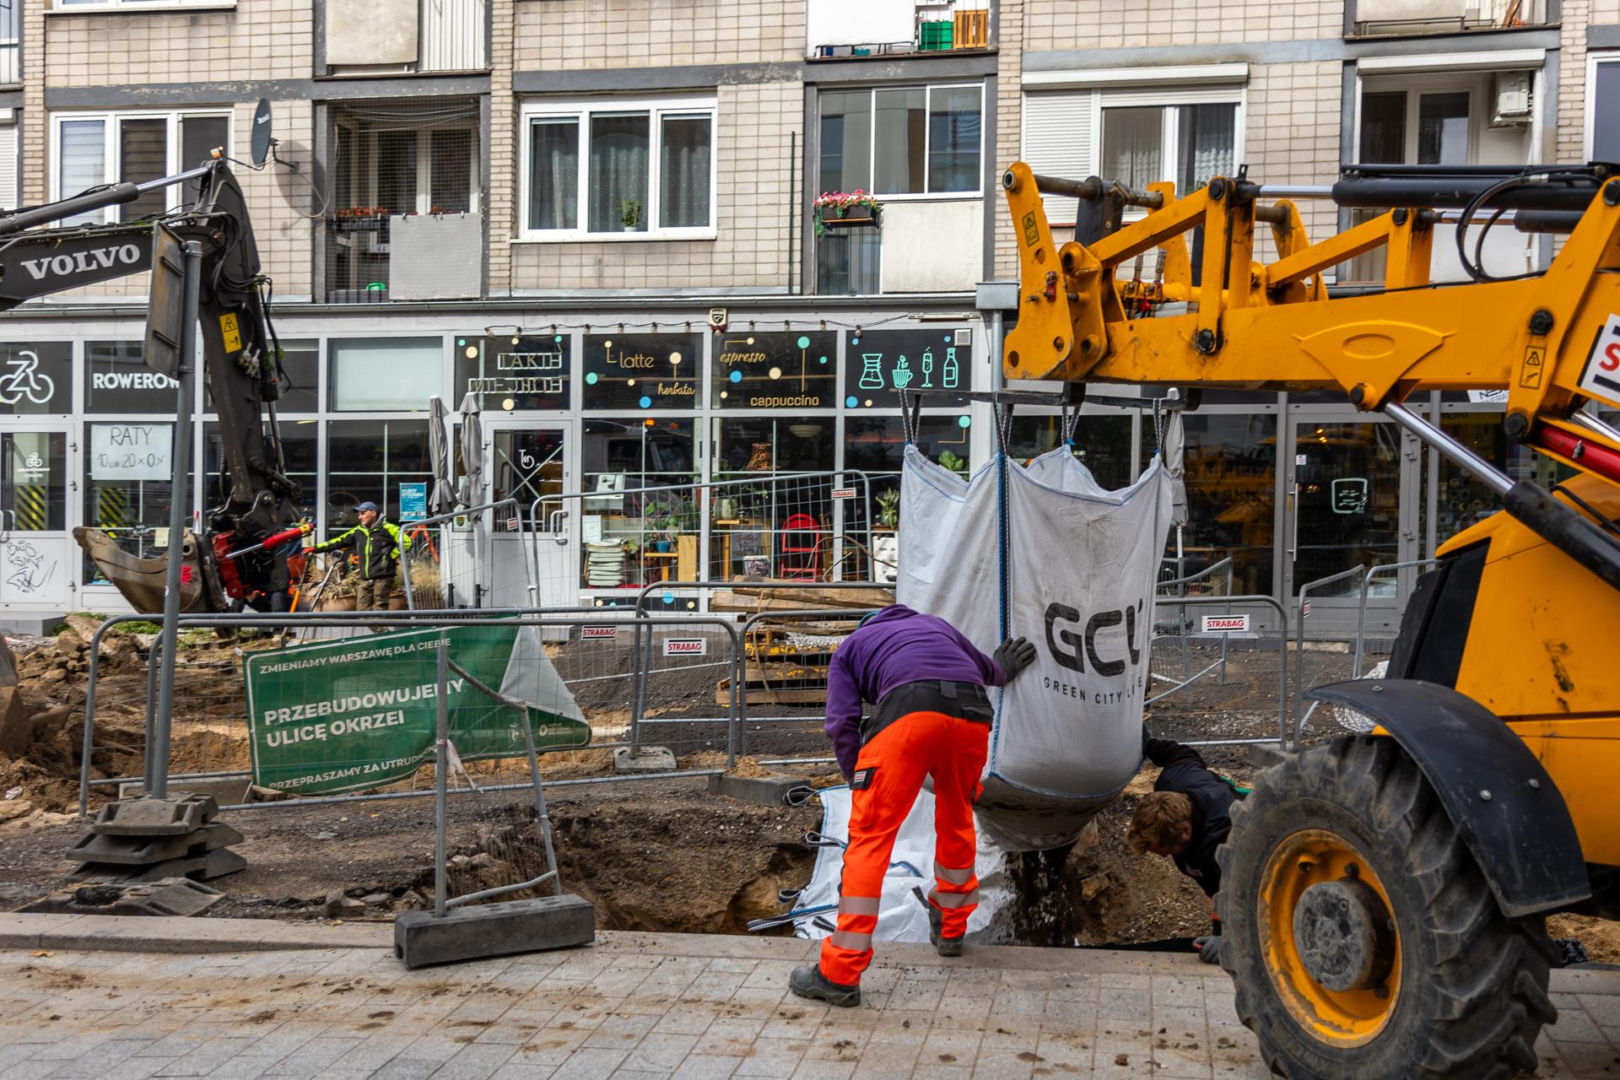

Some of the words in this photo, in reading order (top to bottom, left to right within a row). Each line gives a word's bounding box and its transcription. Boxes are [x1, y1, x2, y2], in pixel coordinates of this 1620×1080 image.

[20, 243, 141, 280] VOLVO
[620, 352, 654, 368] latte
[720, 352, 766, 366] espresso
[657, 382, 696, 395] herbata
[750, 394, 820, 407] cappuccino
[110, 426, 153, 446] RATY
[582, 628, 616, 636] STRABAG
[1207, 620, 1244, 628] STRABAG
[667, 643, 702, 651] STRABAG
[259, 657, 328, 675] ZMIENIAMY
[329, 647, 394, 664] WARSZAWĘ
[393, 644, 416, 655] DLA
[416, 638, 452, 650] CIEBIE
[1043, 677, 1086, 701] GREEN
[1095, 691, 1122, 705] CITY
[266, 723, 327, 747] ULICĘ
[329, 709, 405, 735] OKRZEI
[269, 767, 362, 789] PRZEPRASZAMY
[363, 763, 380, 774] ZA
